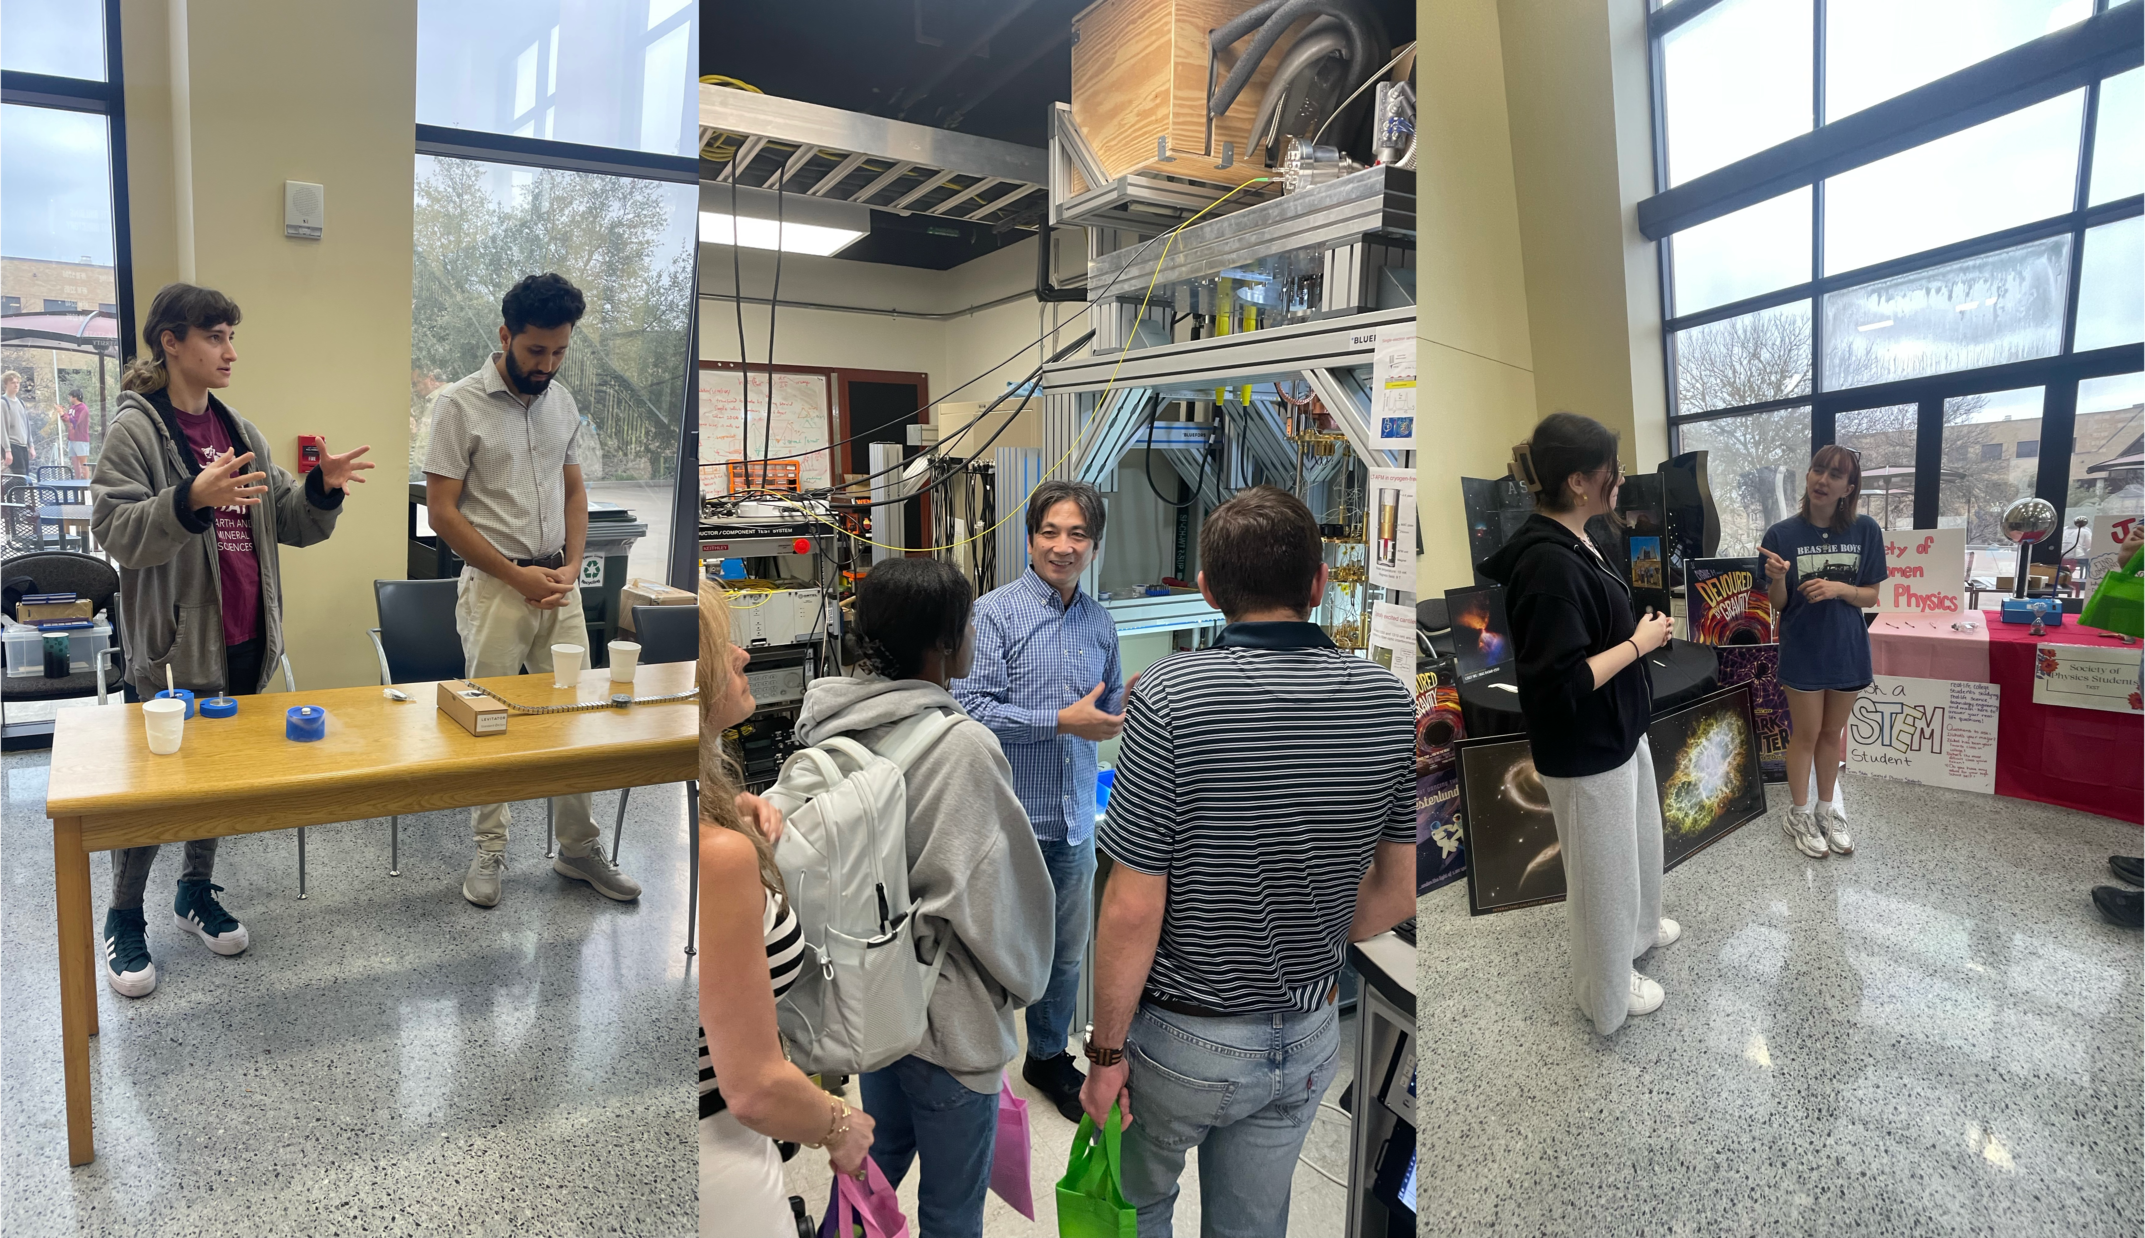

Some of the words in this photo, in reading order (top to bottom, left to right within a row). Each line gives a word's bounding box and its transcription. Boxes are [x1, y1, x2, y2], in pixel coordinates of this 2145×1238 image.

[216, 518, 235, 528] ARTH
[1840, 544, 1862, 553] BOYS
[1916, 536, 1934, 554] of
[1694, 571, 1753, 608] DEVOURED
[1894, 583, 1958, 612] Physics
[1720, 590, 1751, 622] GRAVITY
[2070, 664, 2107, 674] Society
[2109, 667, 2121, 675] of
[2051, 672, 2089, 682] Physics
[2091, 675, 2139, 686] Students
[1892, 685, 1906, 696] a
[1850, 696, 1945, 754] STEM
[1851, 748, 1912, 766] Student
[1416, 784, 1460, 810] esterlund
